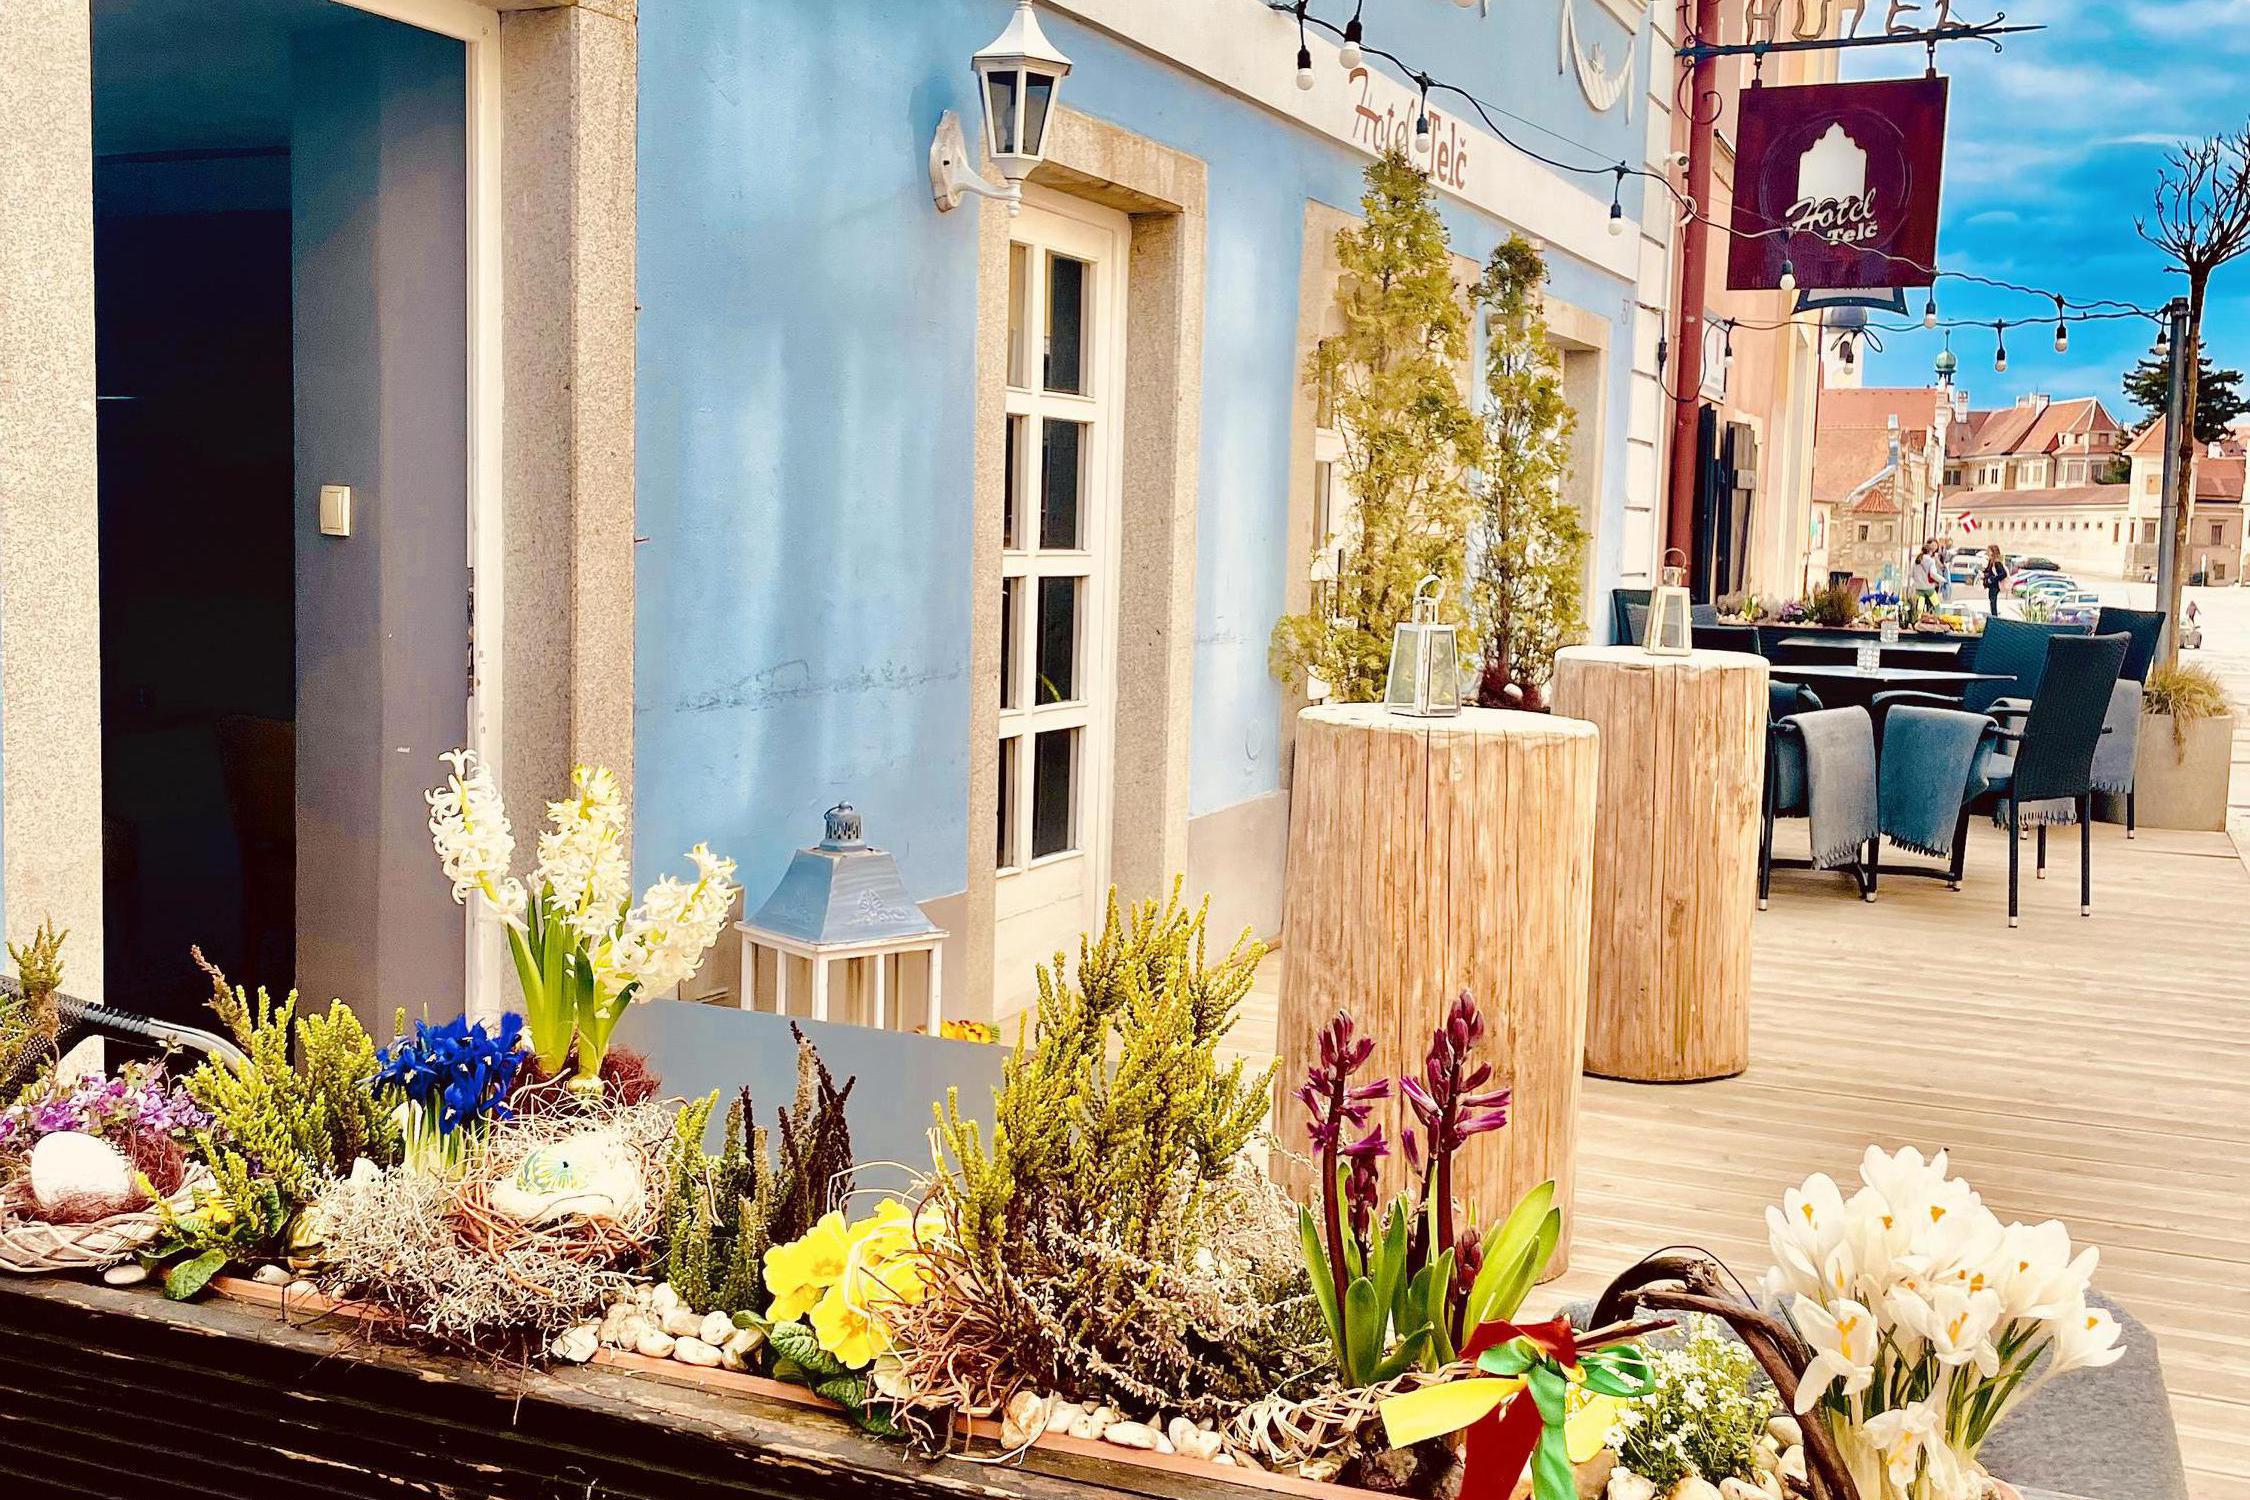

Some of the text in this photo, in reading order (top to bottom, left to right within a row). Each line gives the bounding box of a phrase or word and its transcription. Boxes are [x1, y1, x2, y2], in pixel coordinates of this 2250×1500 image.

[1348, 67, 1467, 190] Hotel Telč
[1785, 187, 1876, 231] Hotel
[1827, 221, 1878, 246] Telč
